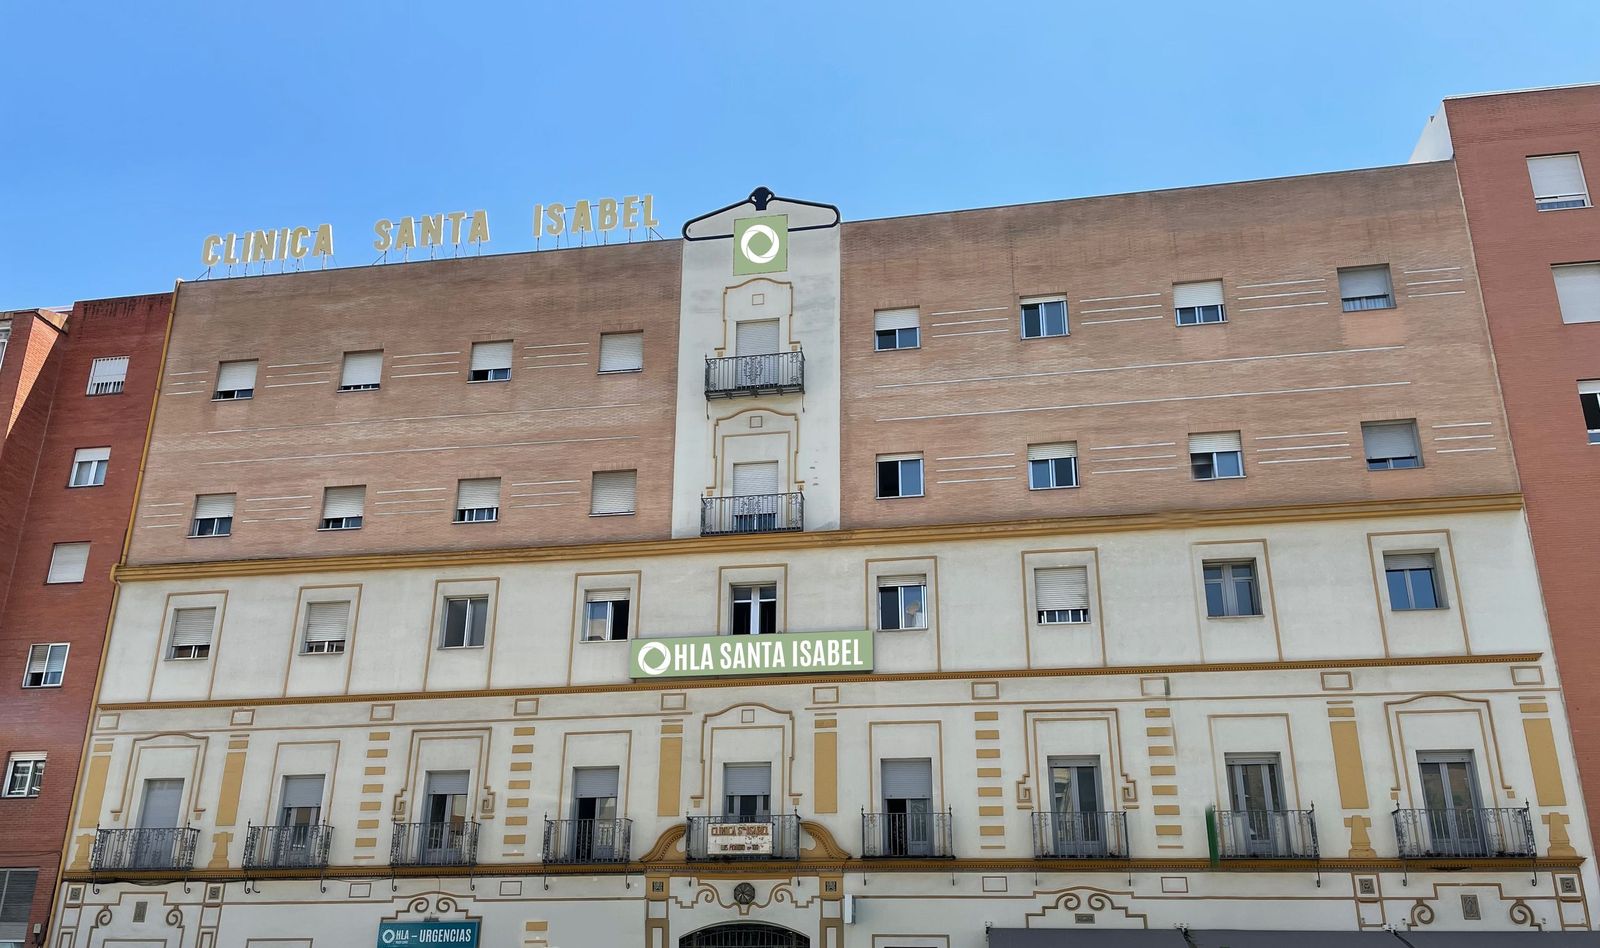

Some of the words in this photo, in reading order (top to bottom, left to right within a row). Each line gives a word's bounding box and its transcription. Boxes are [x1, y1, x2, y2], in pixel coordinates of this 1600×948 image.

[202, 224, 334, 266] CLINICA
[374, 209, 490, 252] SANTA
[533, 194, 659, 238] ISABEL
[674, 643, 714, 671] HLA
[720, 641, 785, 669] SANTA
[793, 639, 863, 667] ISABEL
[395, 929, 409, 940] HLA
[419, 928, 472, 943] URGENCIAS
